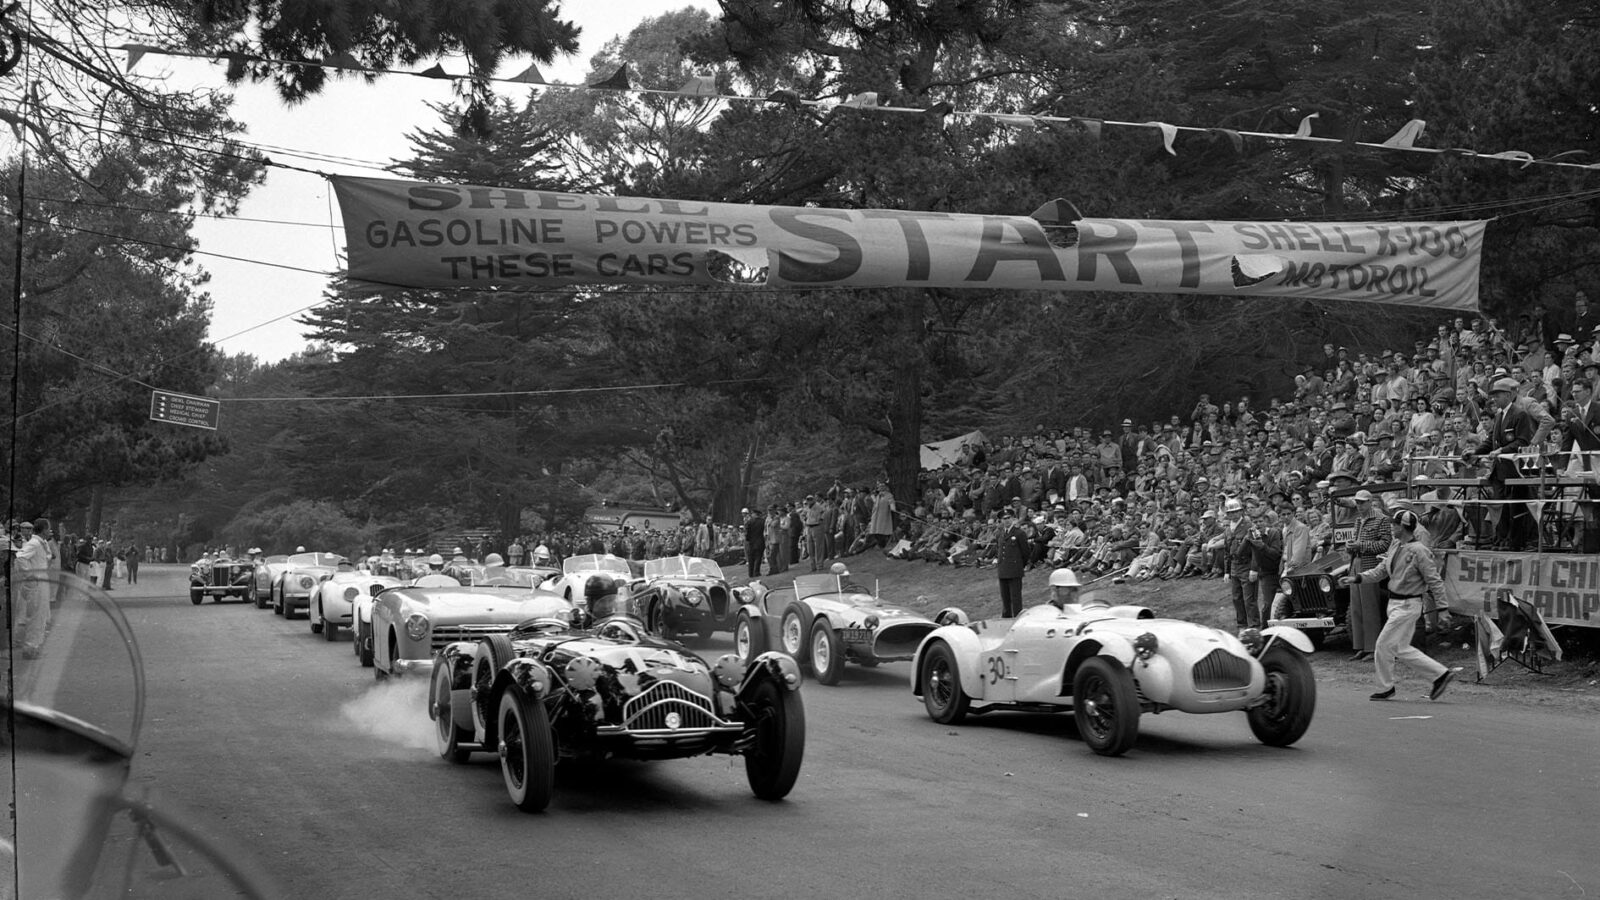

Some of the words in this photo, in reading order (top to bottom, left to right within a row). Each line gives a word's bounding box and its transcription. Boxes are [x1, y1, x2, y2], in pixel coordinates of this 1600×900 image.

[408, 187, 708, 216] SHELL
[366, 219, 565, 248] GASOLINE
[595, 220, 757, 246] POWERS
[1233, 224, 1366, 254] SHELL
[1366, 226, 1468, 260] X-100
[768, 208, 1214, 289] START
[441, 252, 575, 280] THESE
[597, 252, 695, 277] CARS
[1458, 557, 1523, 585] SEND
[1528, 559, 1541, 586] A
[988, 656, 1005, 685] 30
